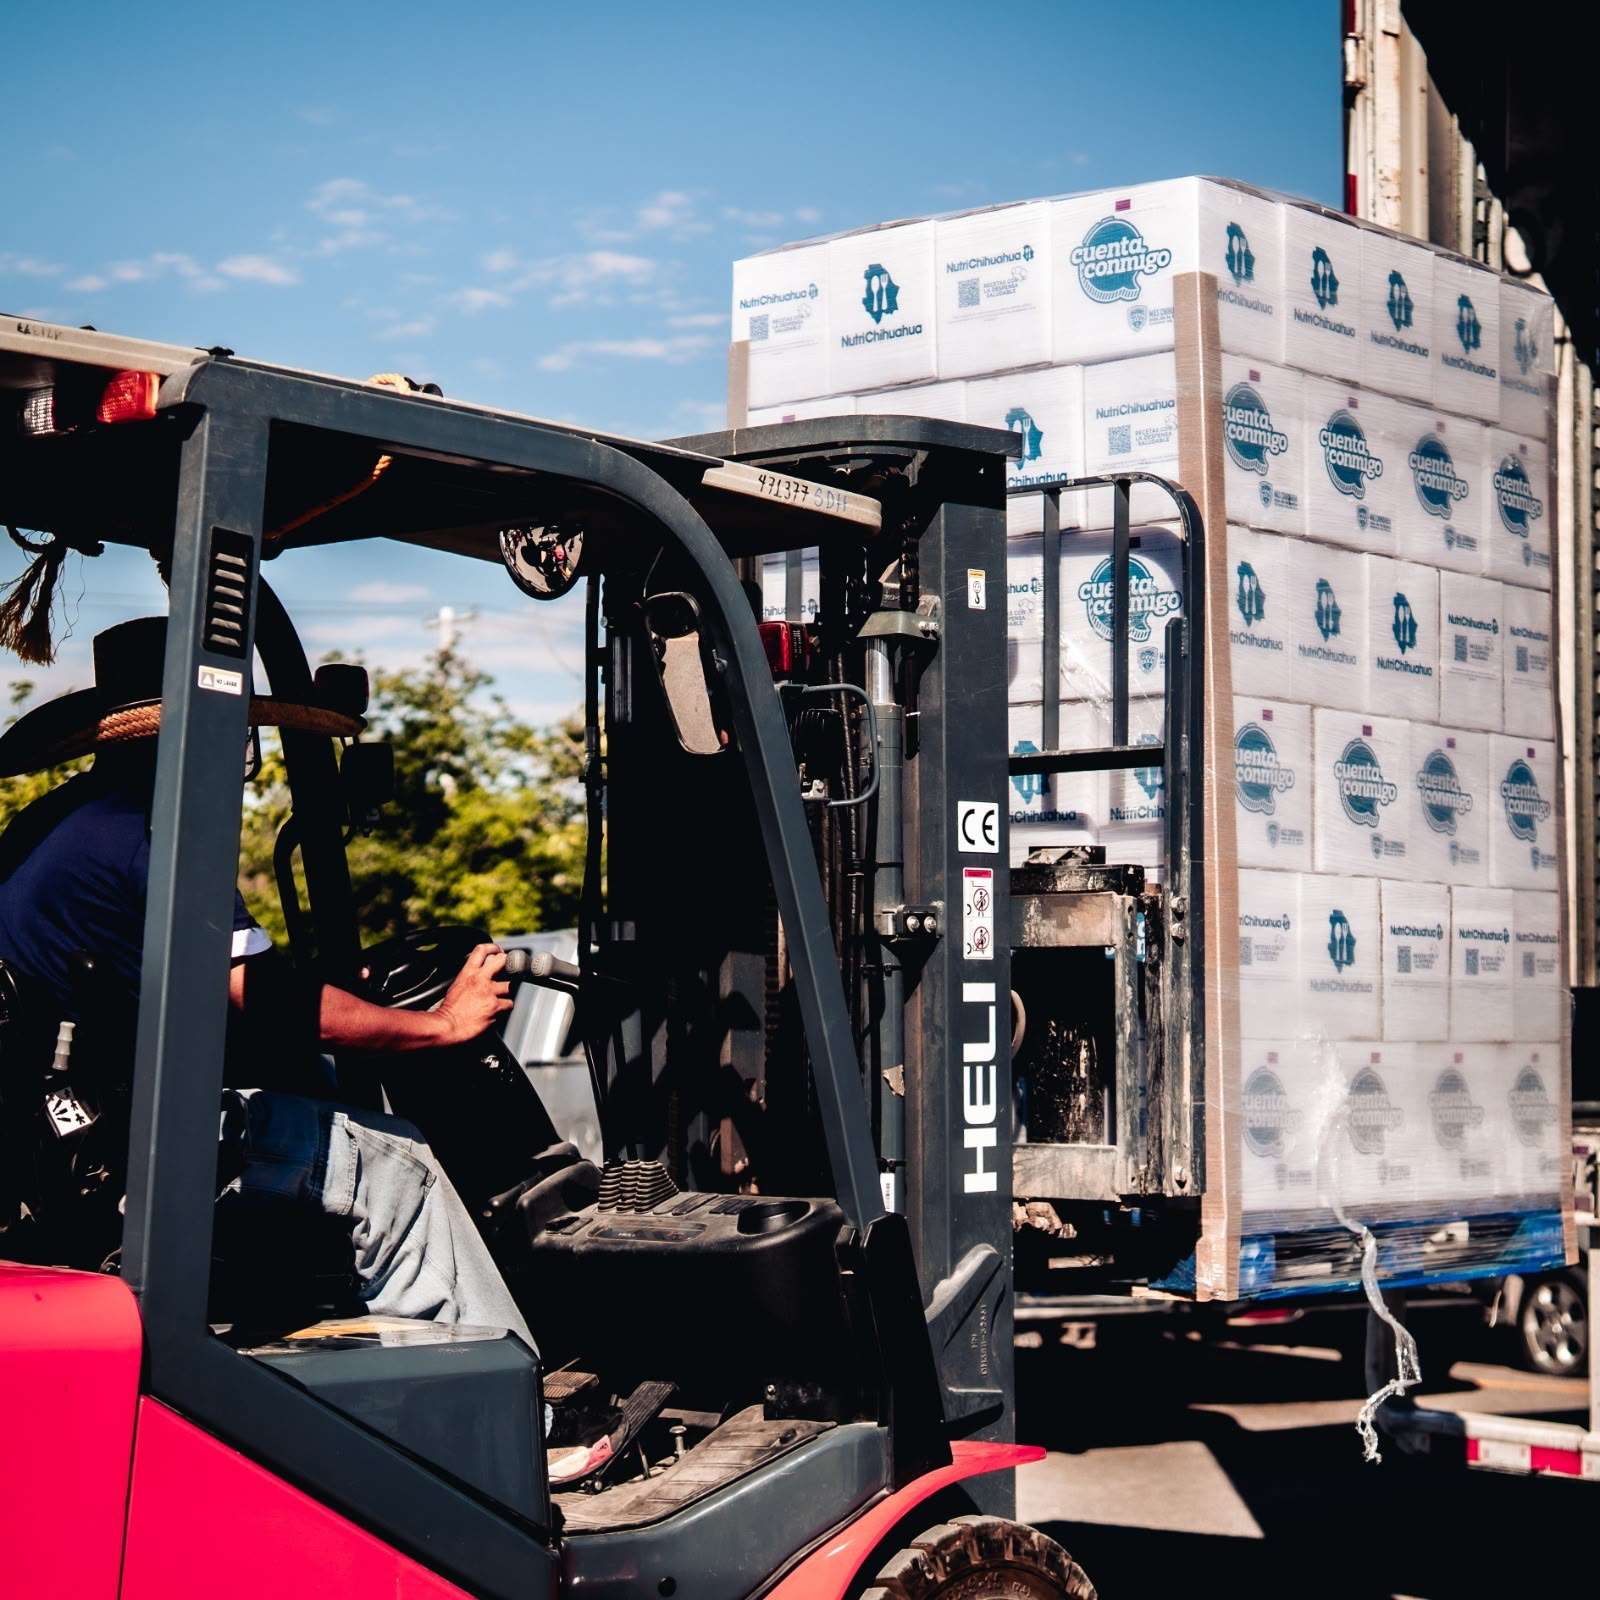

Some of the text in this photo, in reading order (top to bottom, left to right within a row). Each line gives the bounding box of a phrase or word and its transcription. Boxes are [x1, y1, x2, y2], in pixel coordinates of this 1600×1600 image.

[1071, 236, 1146, 264] cuenta
[946, 252, 1022, 274] NutriChihuahua
[1083, 250, 1171, 278] conmigo
[740, 289, 807, 309] NutriChihuahua
[1294, 308, 1356, 338] NutriChihuahua
[841, 324, 922, 349] NutriChihuahua
[1096, 400, 1175, 419] NutriChihuahua
[1222, 404, 1272, 432] uenta
[1227, 423, 1288, 454] conmigo
[1319, 429, 1369, 457] cuenta
[1329, 449, 1382, 479] conmigo
[1409, 453, 1456, 477] cuenta
[1417, 470, 1468, 499] conmigo
[1494, 473, 1532, 497] cuenta
[1501, 492, 1542, 518] conmigo
[1079, 575, 1158, 600] cueta
[1092, 592, 1181, 616] comigo
[1230, 631, 1284, 650] triChihuahua
[1299, 643, 1357, 665] NutriChihuahua
[1377, 656, 1432, 676] NutriChihuahua
[1234, 747, 1279, 768] uenta
[1235, 766, 1295, 792] conmigo
[1334, 761, 1383, 781] cuenta
[1417, 771, 1460, 791] cuenta
[1343, 779, 1397, 806] conmigo
[1501, 781, 1540, 799] cuenta
[1110, 806, 1164, 822] NutriChih
[1424, 790, 1472, 815] conmigo
[1508, 799, 1550, 822] conmigo
[1390, 924, 1436, 938] NutriChihuahua
[1310, 979, 1373, 993] NutriChihuahua
[962, 982, 997, 1193] HELI
